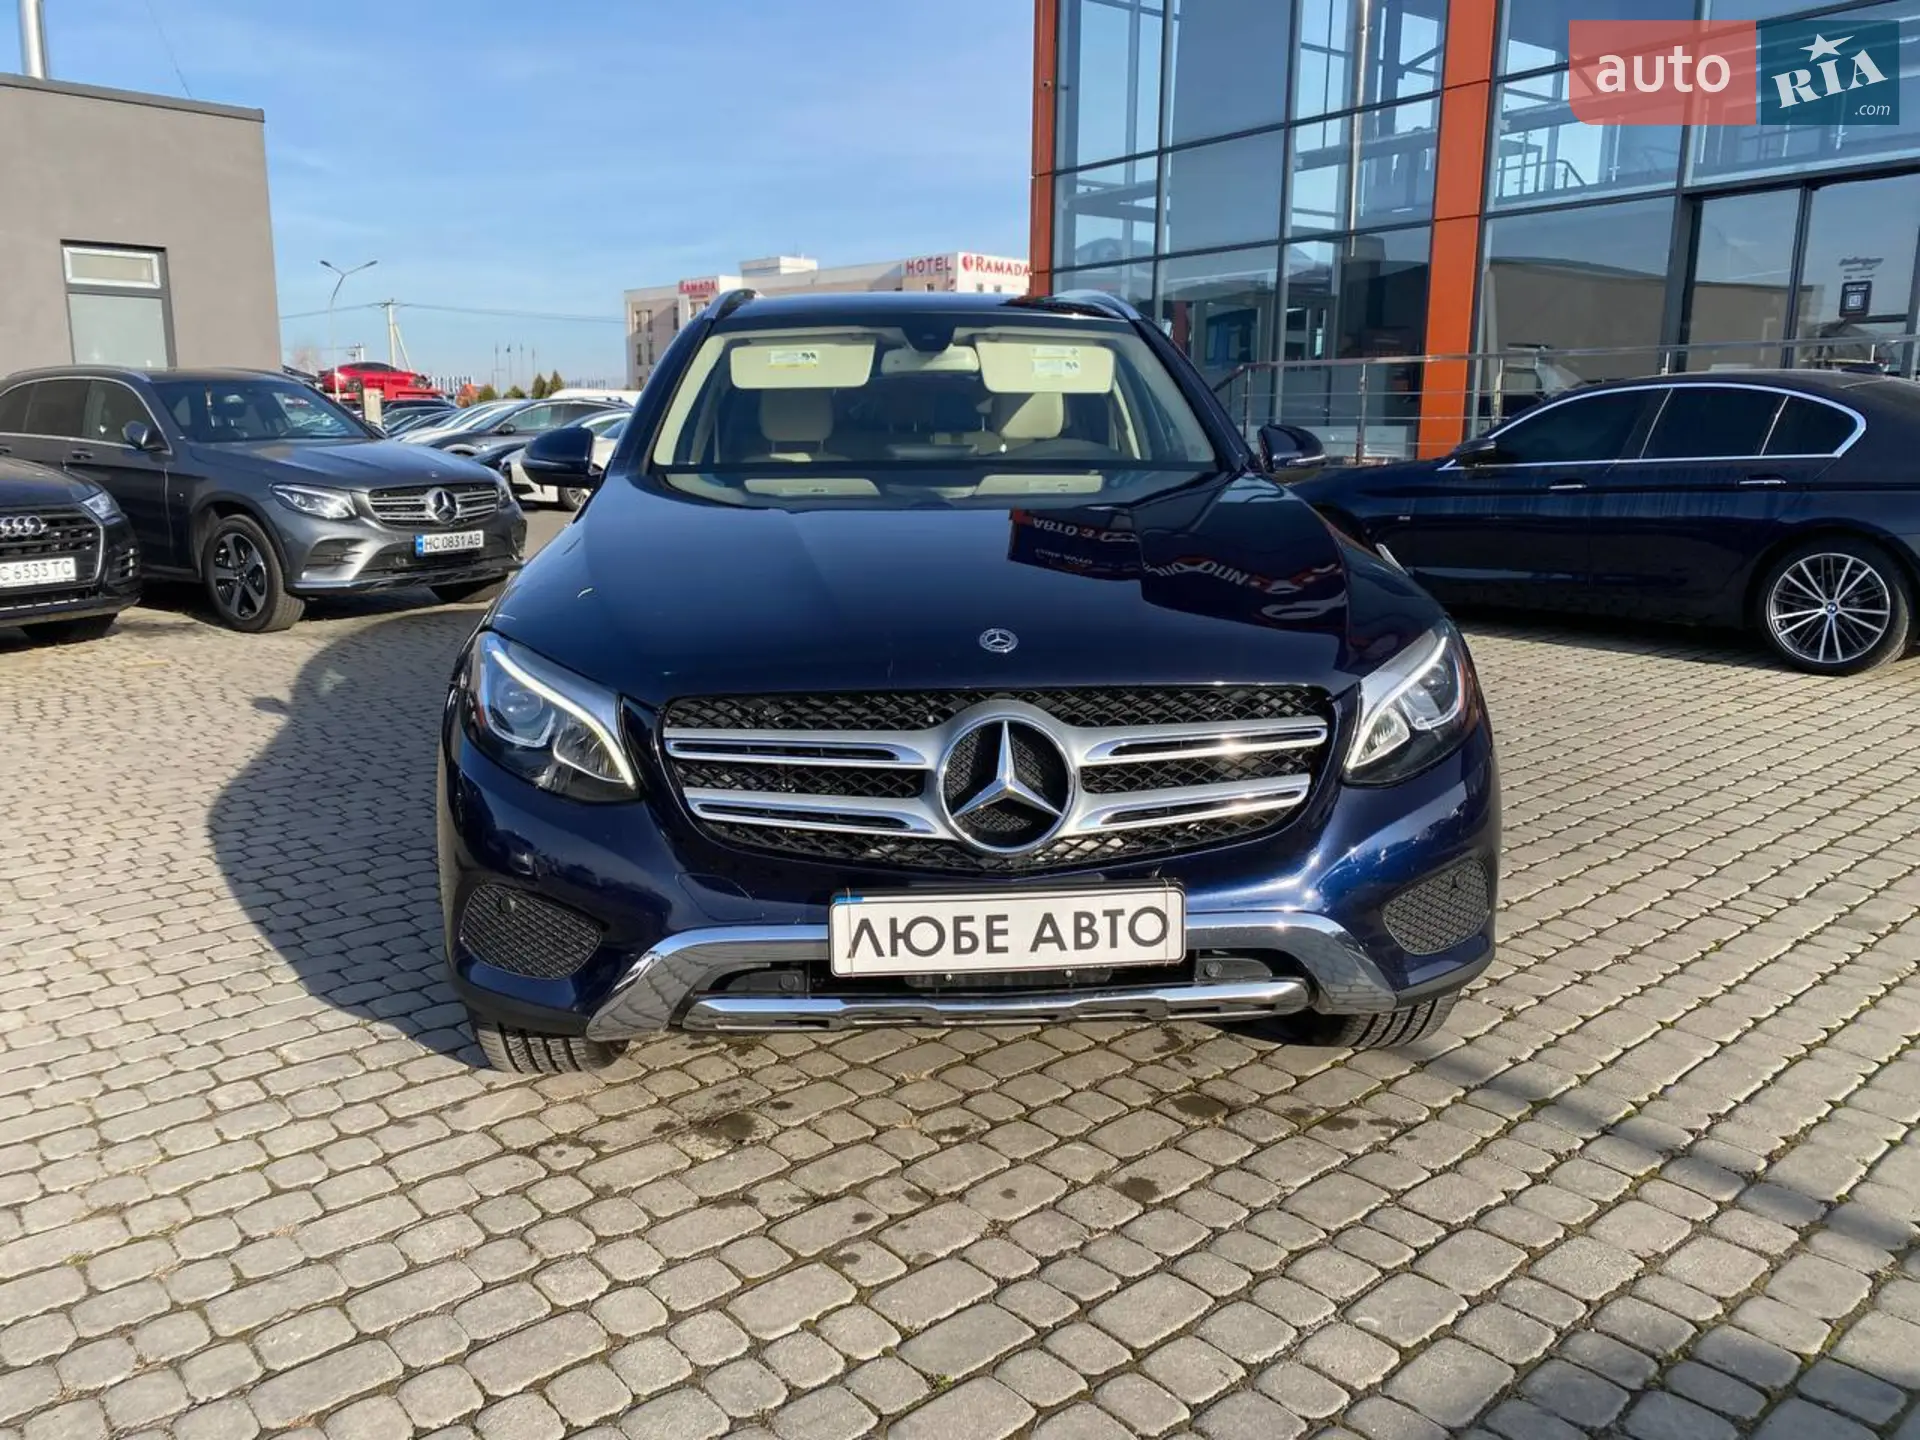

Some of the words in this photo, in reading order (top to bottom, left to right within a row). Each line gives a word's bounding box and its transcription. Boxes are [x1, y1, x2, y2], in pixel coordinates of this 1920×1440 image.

[905, 256, 952, 274] HOTEL
[51, 560, 72, 575] TC
[846, 914, 1010, 959] ЛЮБЕ
[1029, 905, 1169, 953] АВТО
